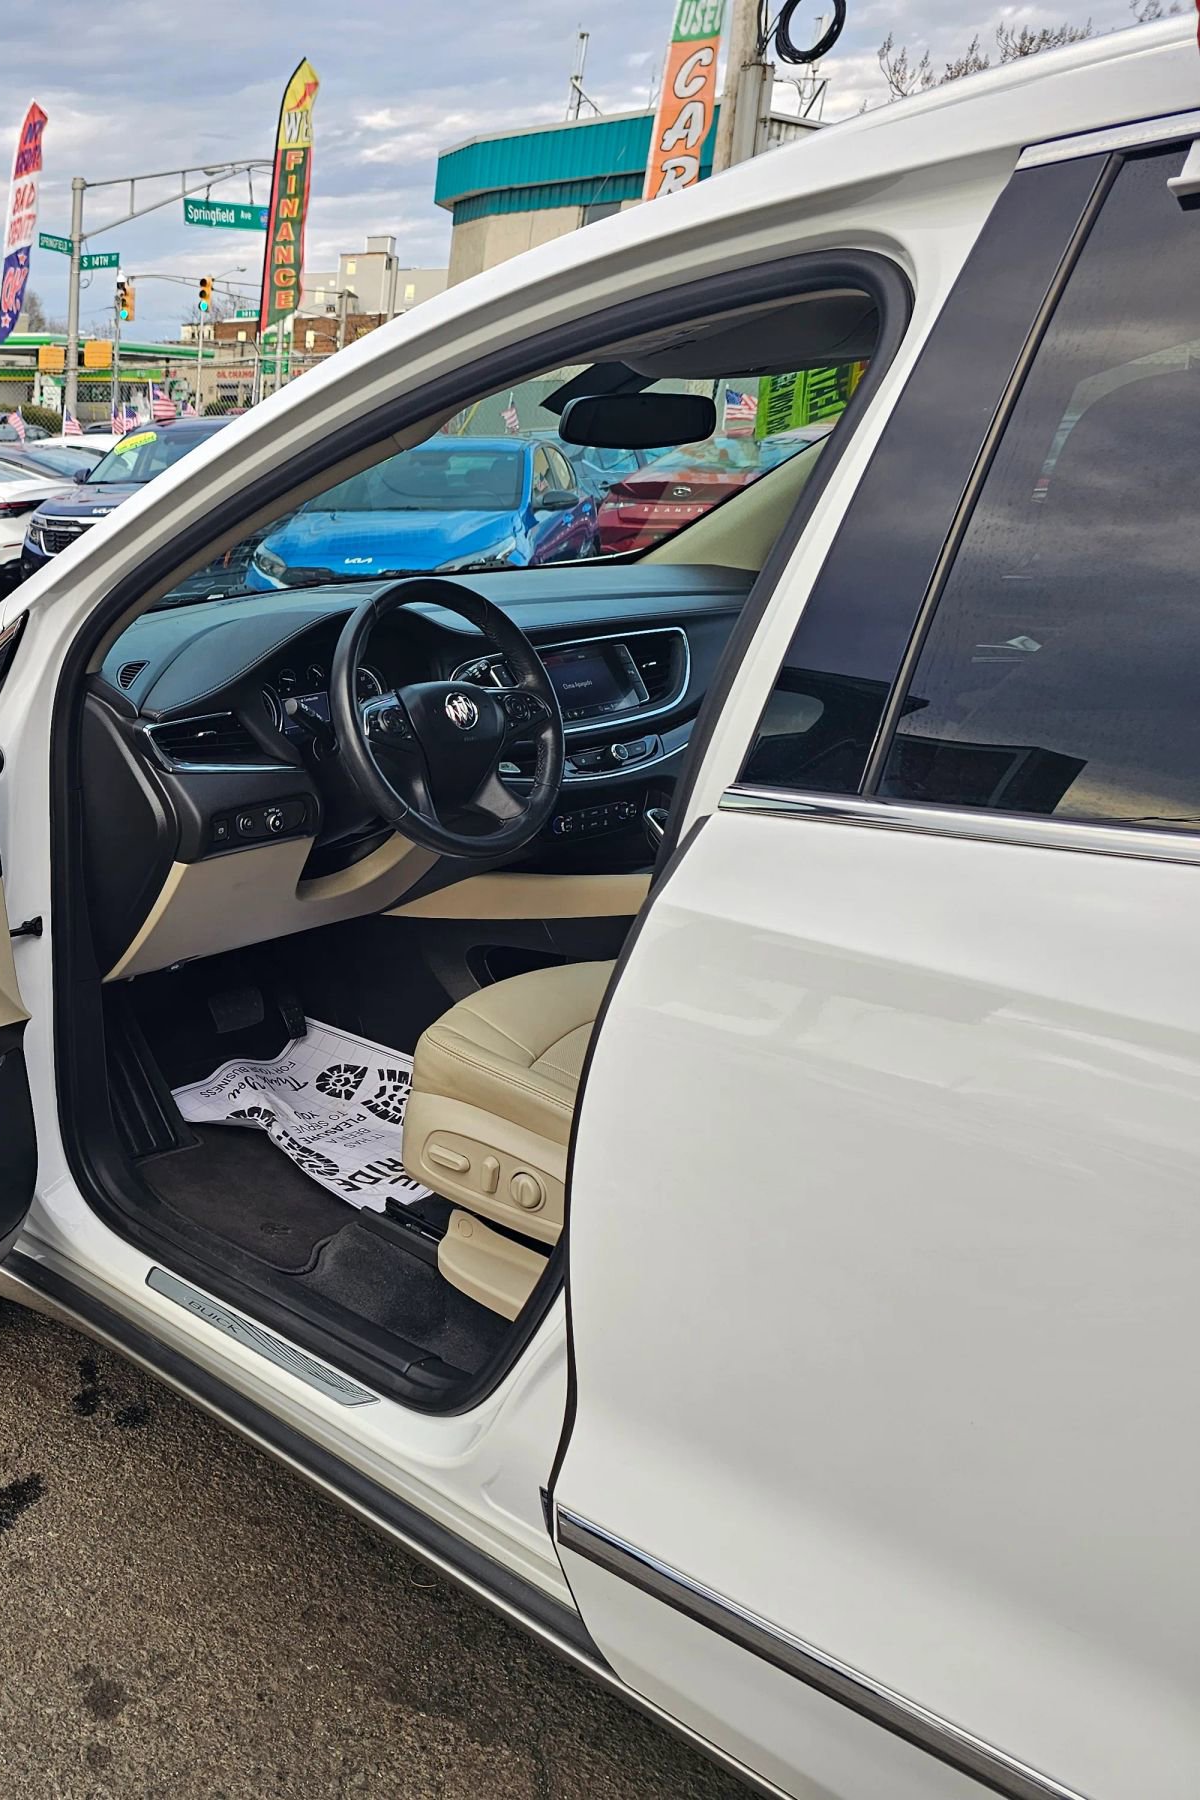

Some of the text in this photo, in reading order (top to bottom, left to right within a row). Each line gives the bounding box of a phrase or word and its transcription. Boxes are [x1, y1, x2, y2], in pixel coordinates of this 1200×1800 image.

[188, 204, 235, 226] Springfield
[240, 210, 252, 220] Ave
[274, 150, 304, 310] FINANCE
[82, 256, 88, 267] S
[92, 255, 109, 267] 14TH
[200, 1066, 250, 1098] BUSINESS
[291, 1110, 348, 1134] TO SERVE
[299, 1113, 367, 1144] PLEASURE
[337, 1127, 371, 1141] BEEN
[188, 1300, 241, 1334] BUICK
